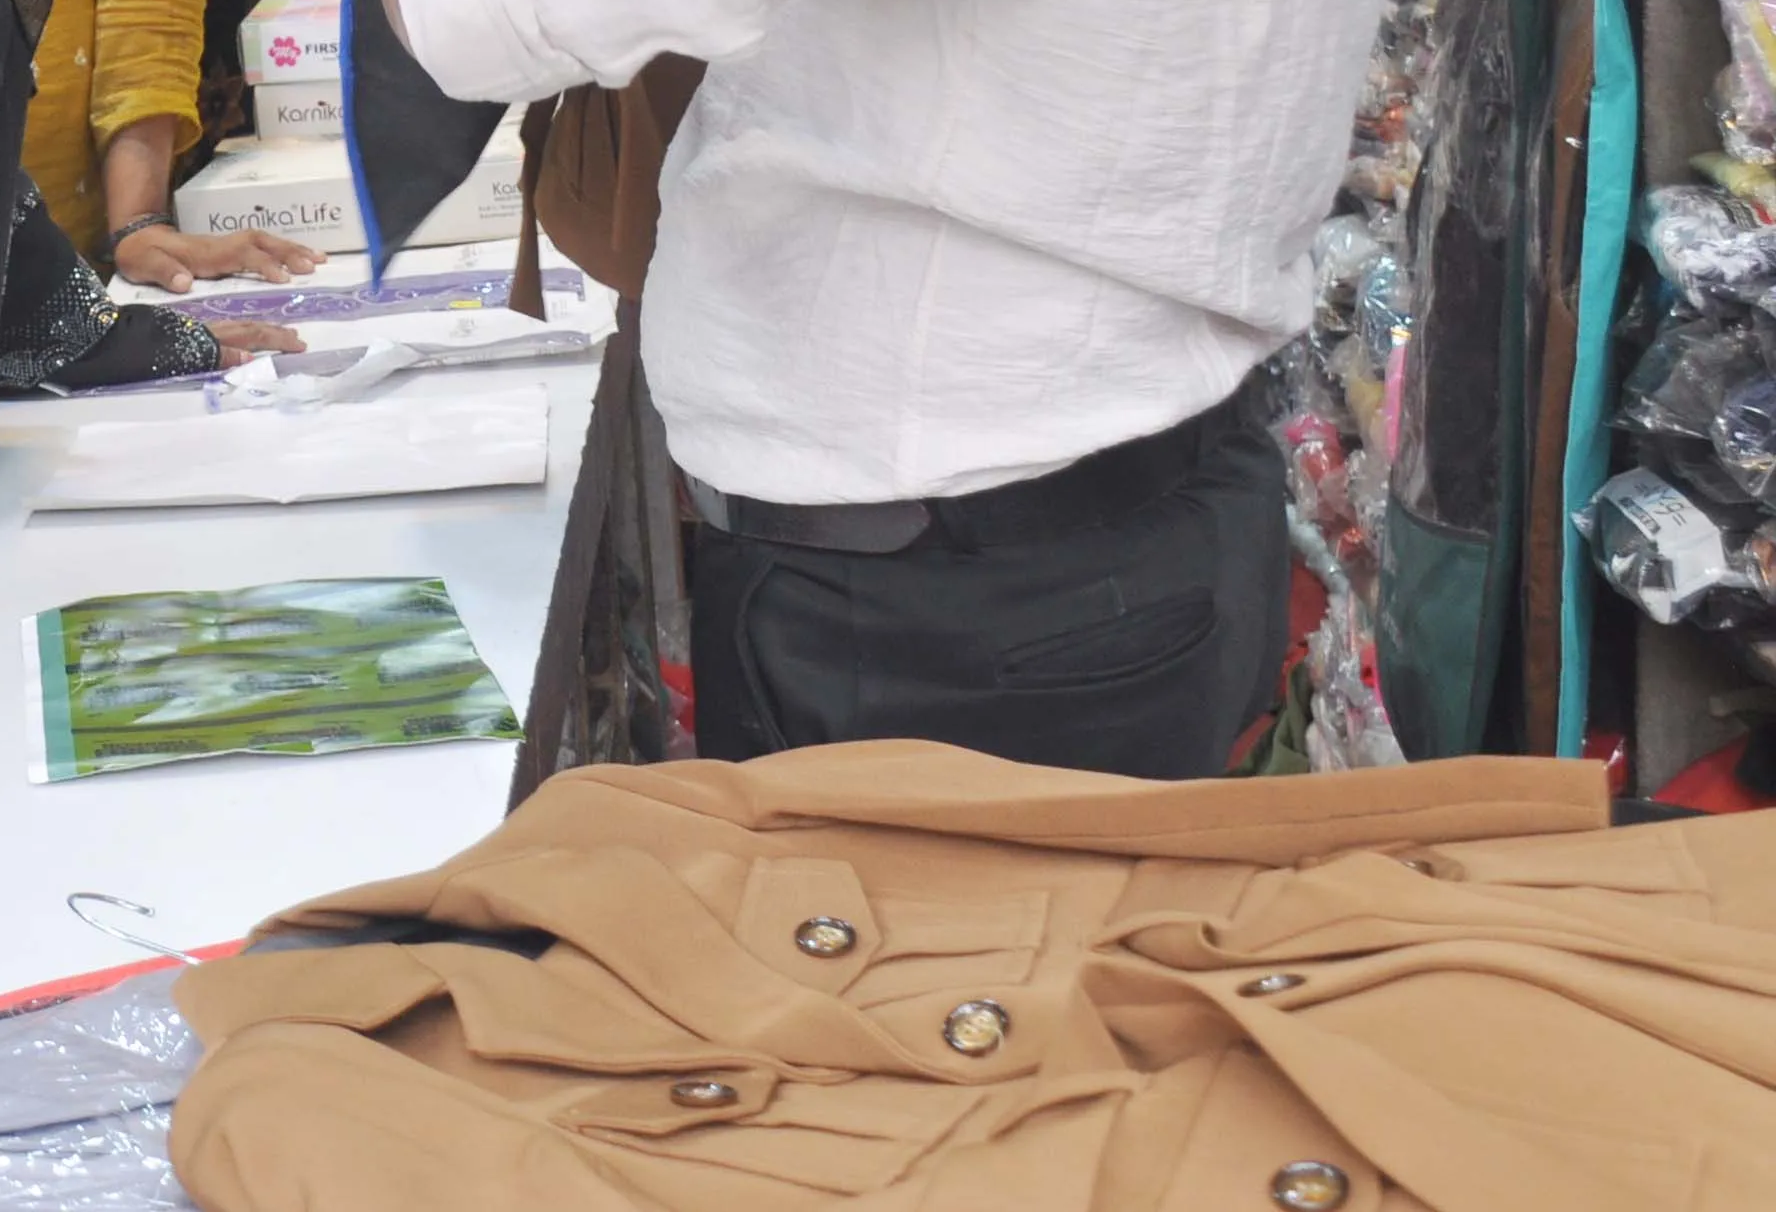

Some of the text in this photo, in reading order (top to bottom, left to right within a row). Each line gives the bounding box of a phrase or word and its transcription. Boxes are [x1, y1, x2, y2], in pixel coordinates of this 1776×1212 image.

[305, 42, 340, 55] FIRS
[208, 202, 342, 233] Karnika Life
